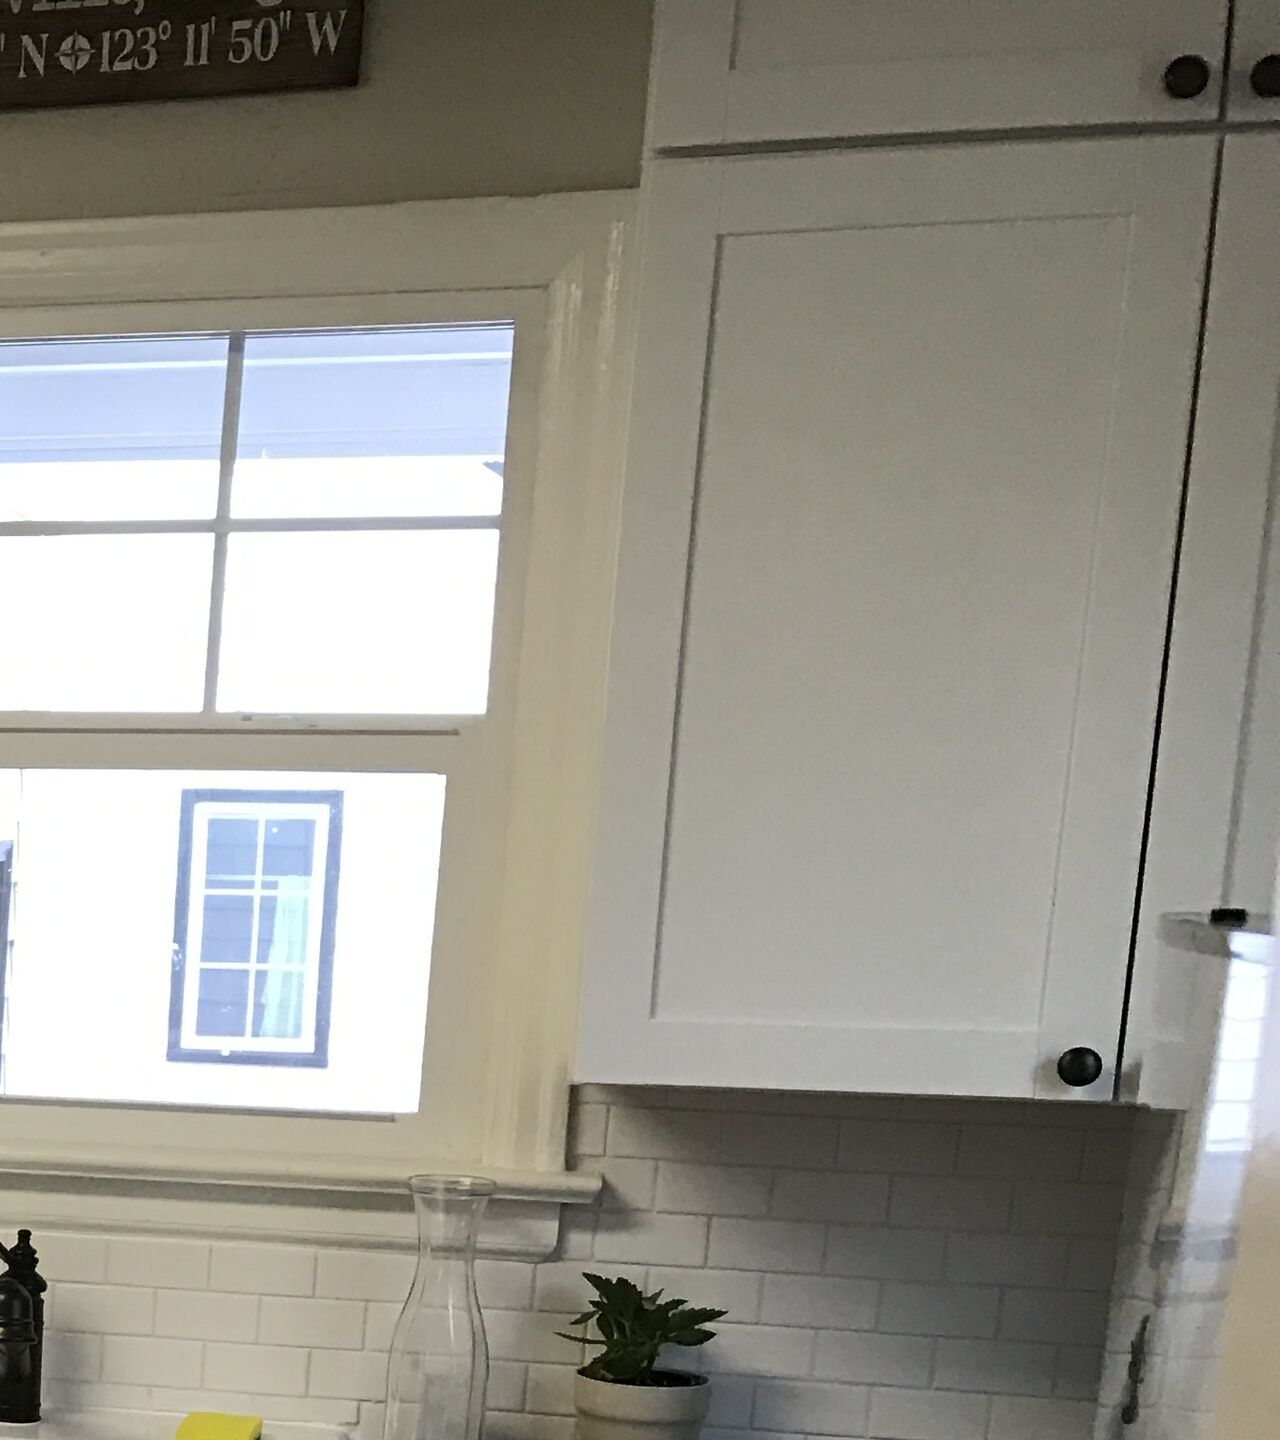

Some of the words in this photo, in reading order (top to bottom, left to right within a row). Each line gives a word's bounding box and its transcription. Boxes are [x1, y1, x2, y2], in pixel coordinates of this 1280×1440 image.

[17, 33, 50, 78] N
[99, 20, 172, 73] 123°
[305, 10, 347, 56] W
